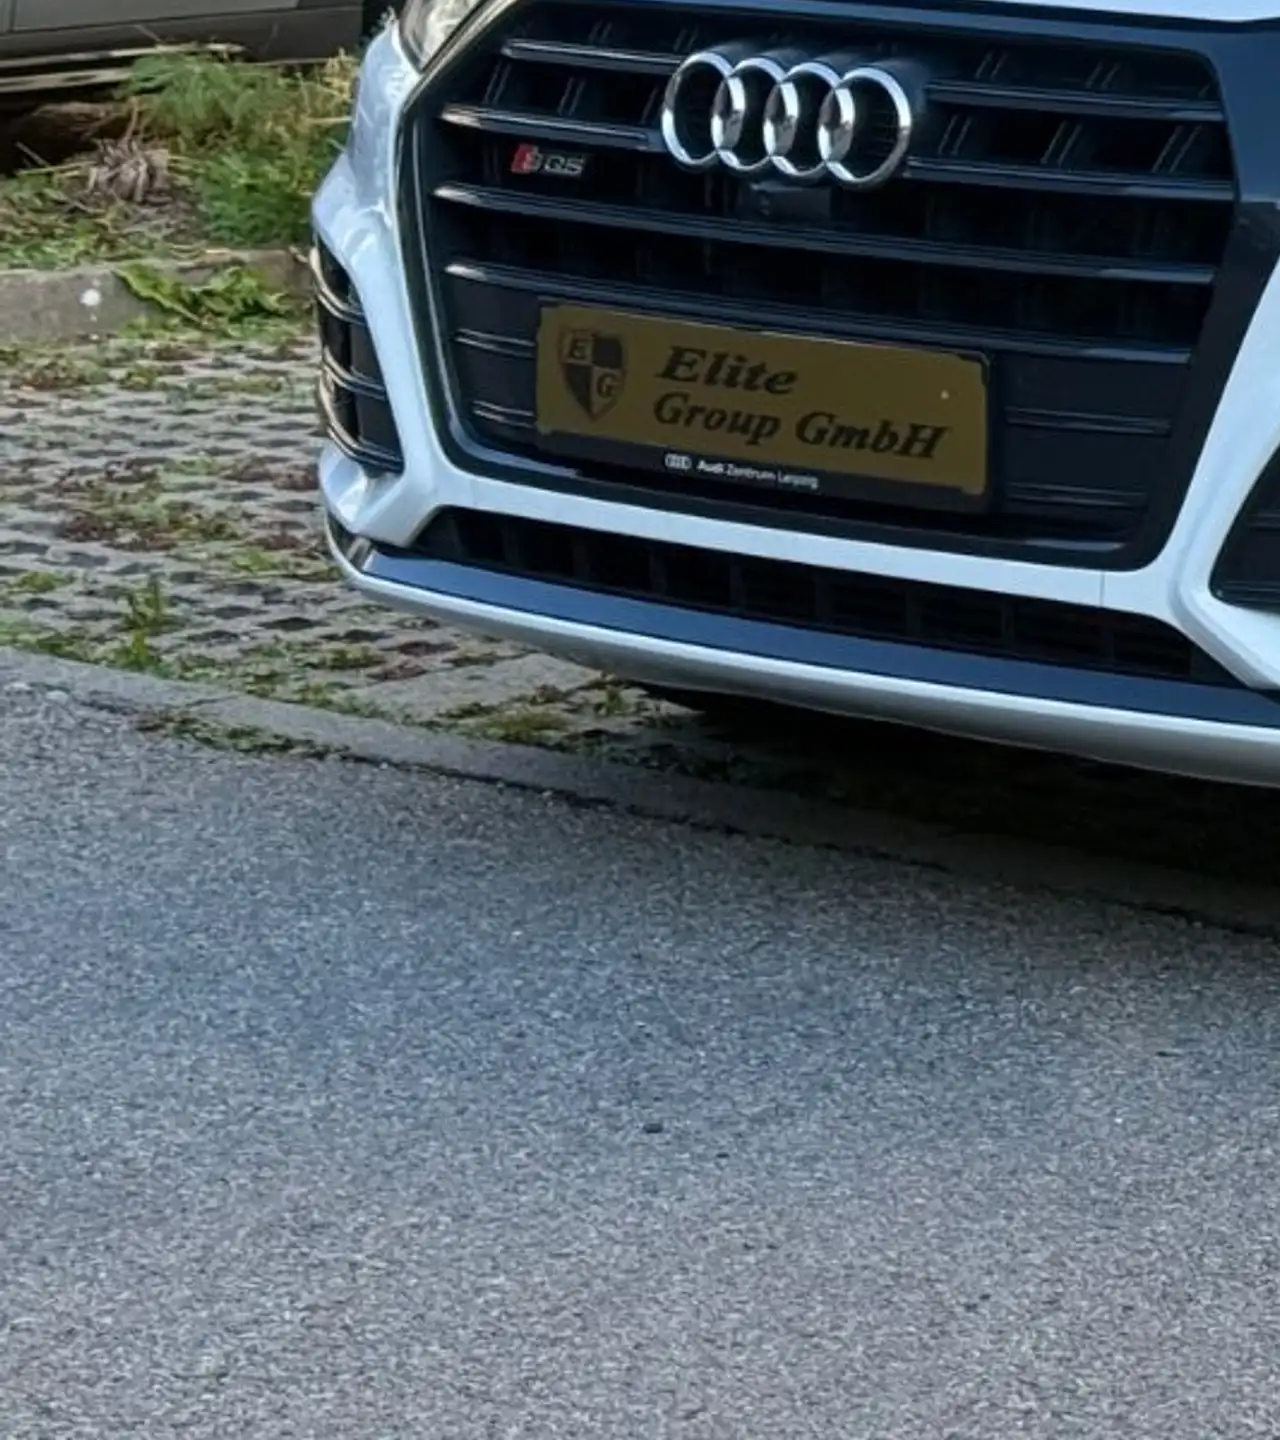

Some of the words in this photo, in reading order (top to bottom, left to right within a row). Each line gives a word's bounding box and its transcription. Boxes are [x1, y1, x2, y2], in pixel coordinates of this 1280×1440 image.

[568, 335, 590, 361] E
[654, 345, 797, 394] Elite
[597, 372, 618, 399] G
[653, 391, 780, 446] Group
[795, 411, 947, 459] GmbH
[697, 460, 724, 474] Audi
[726, 464, 776, 480] Zentrum
